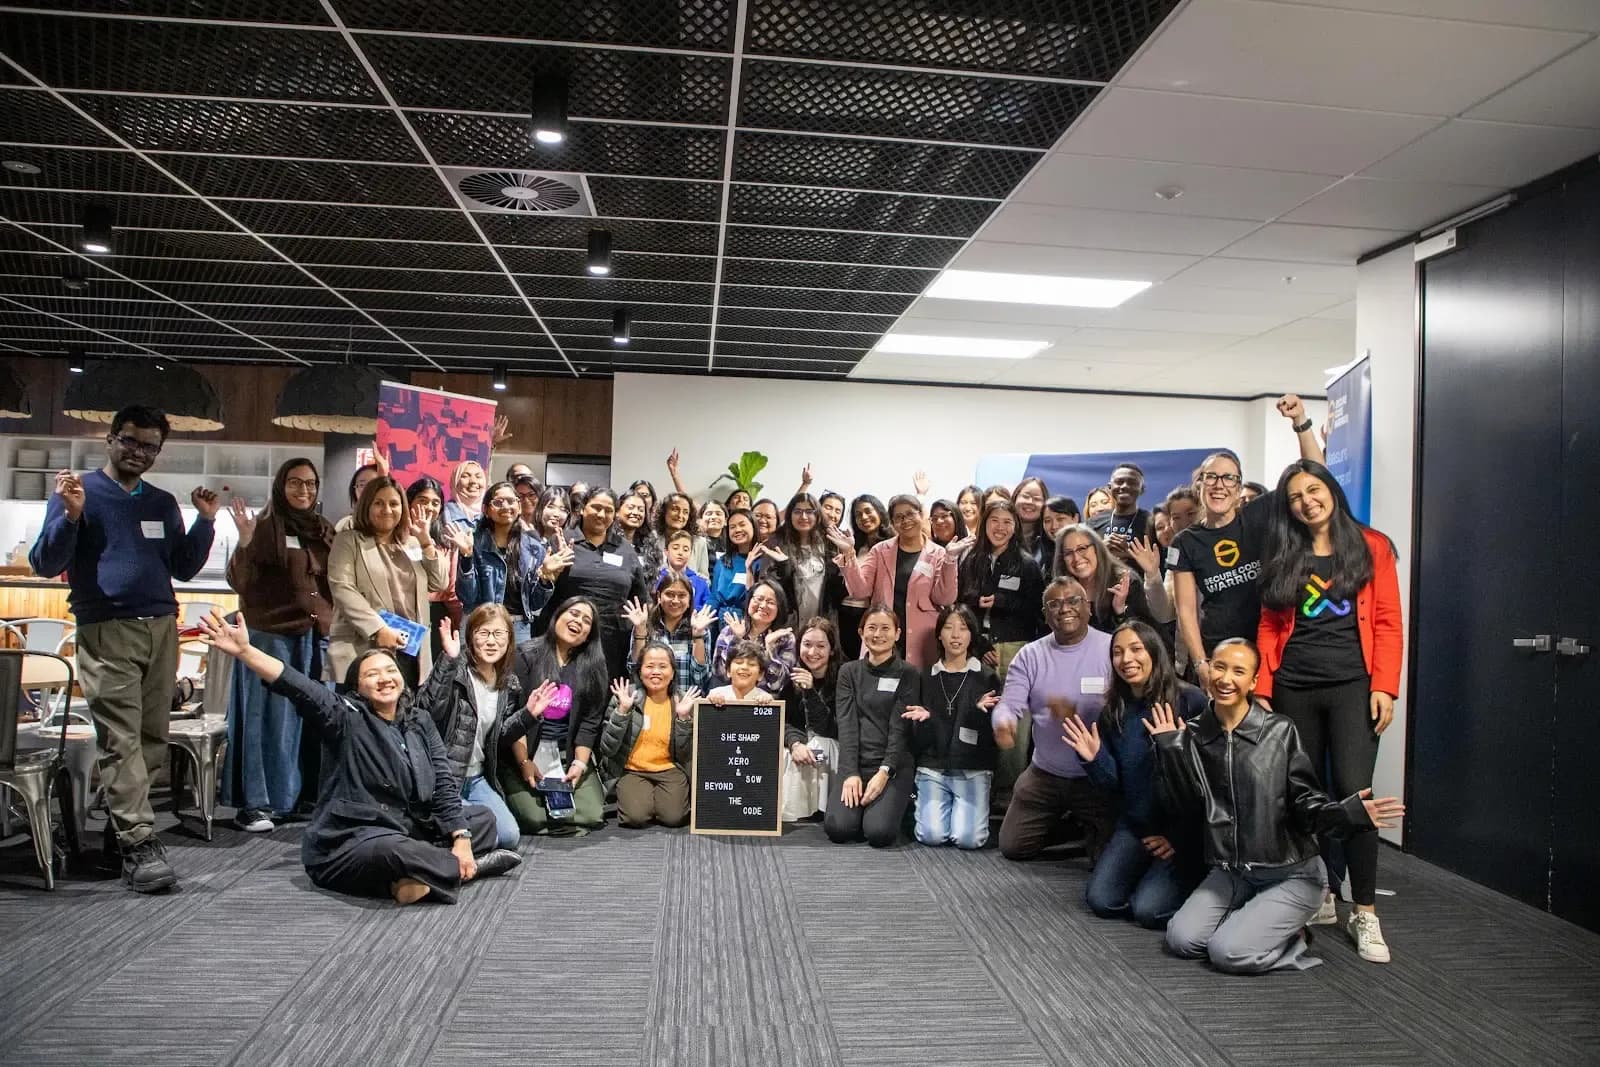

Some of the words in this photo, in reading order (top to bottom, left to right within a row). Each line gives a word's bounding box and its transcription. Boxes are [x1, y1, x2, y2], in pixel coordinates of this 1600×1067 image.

[1203, 569, 1238, 586] SECURE
[720, 733, 737, 742] SHE
[737, 733, 760, 742] SHARP
[728, 757, 750, 766] XERO
[745, 775, 762, 784] SOW
[704, 781, 734, 791] BEYOND
[728, 796, 742, 805] THE
[742, 806, 762, 816] CODE
